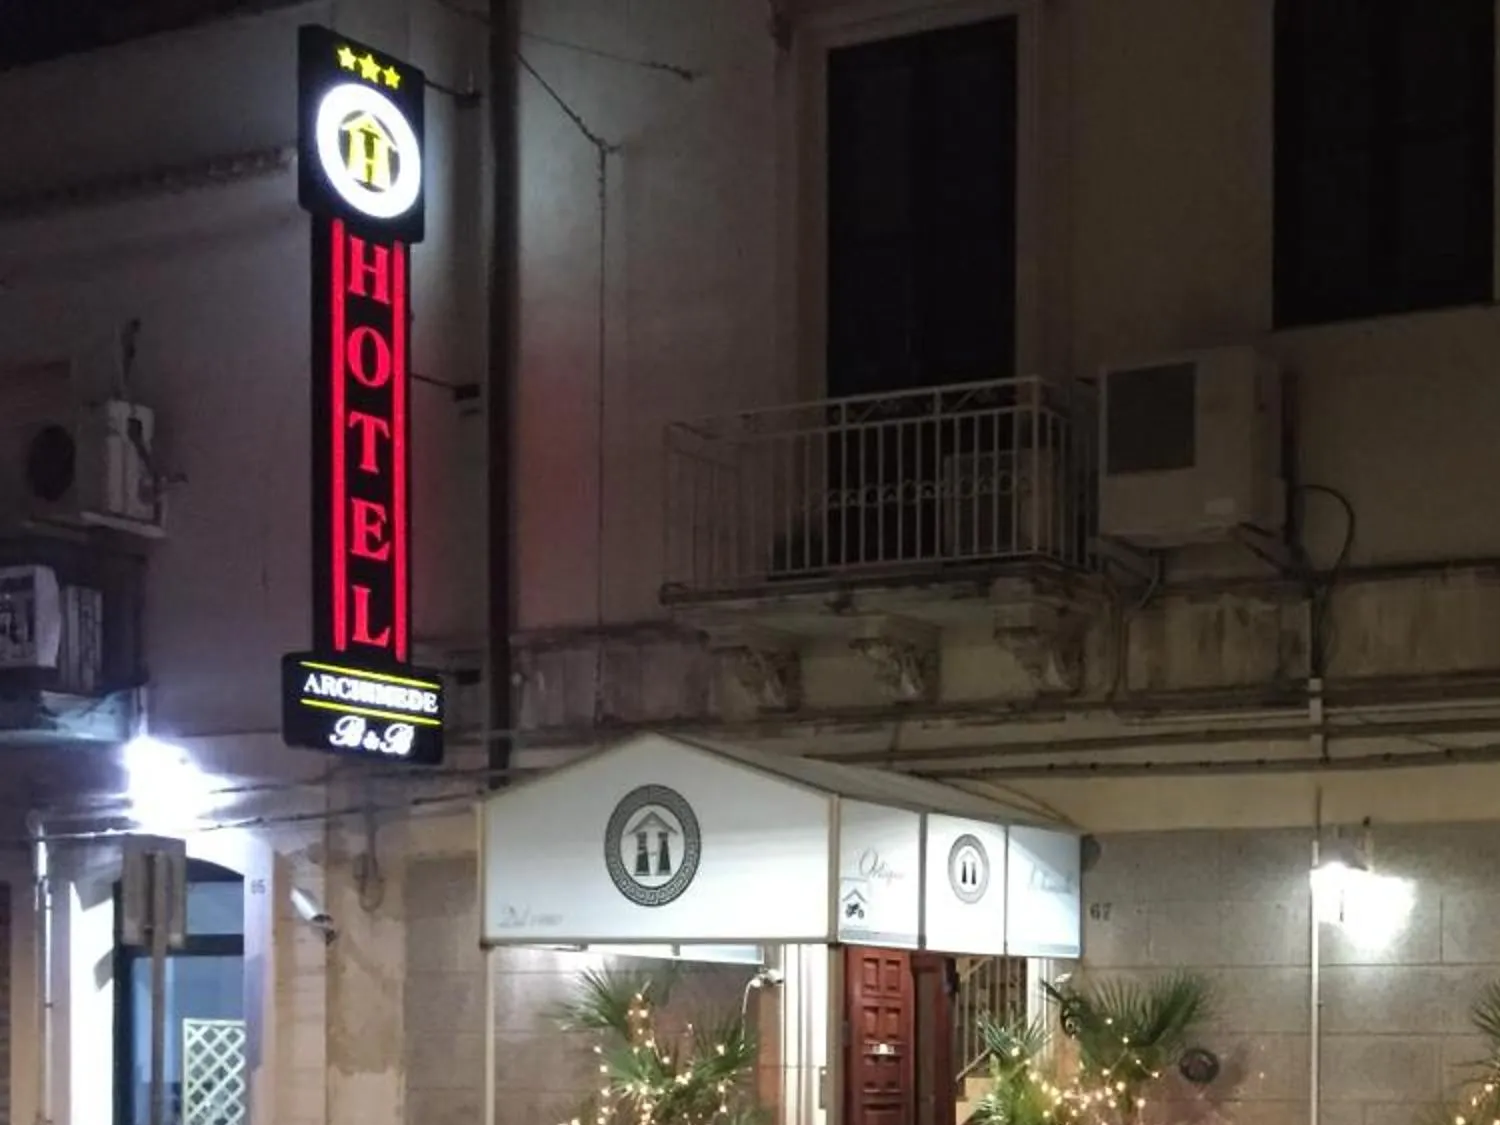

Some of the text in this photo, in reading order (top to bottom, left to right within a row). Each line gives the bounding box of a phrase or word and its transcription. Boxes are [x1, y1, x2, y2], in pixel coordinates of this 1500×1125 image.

[347, 233, 391, 648] HOTEL
[303, 673, 439, 713] ARCHIMEDE
[1089, 901, 1113, 922] 67
